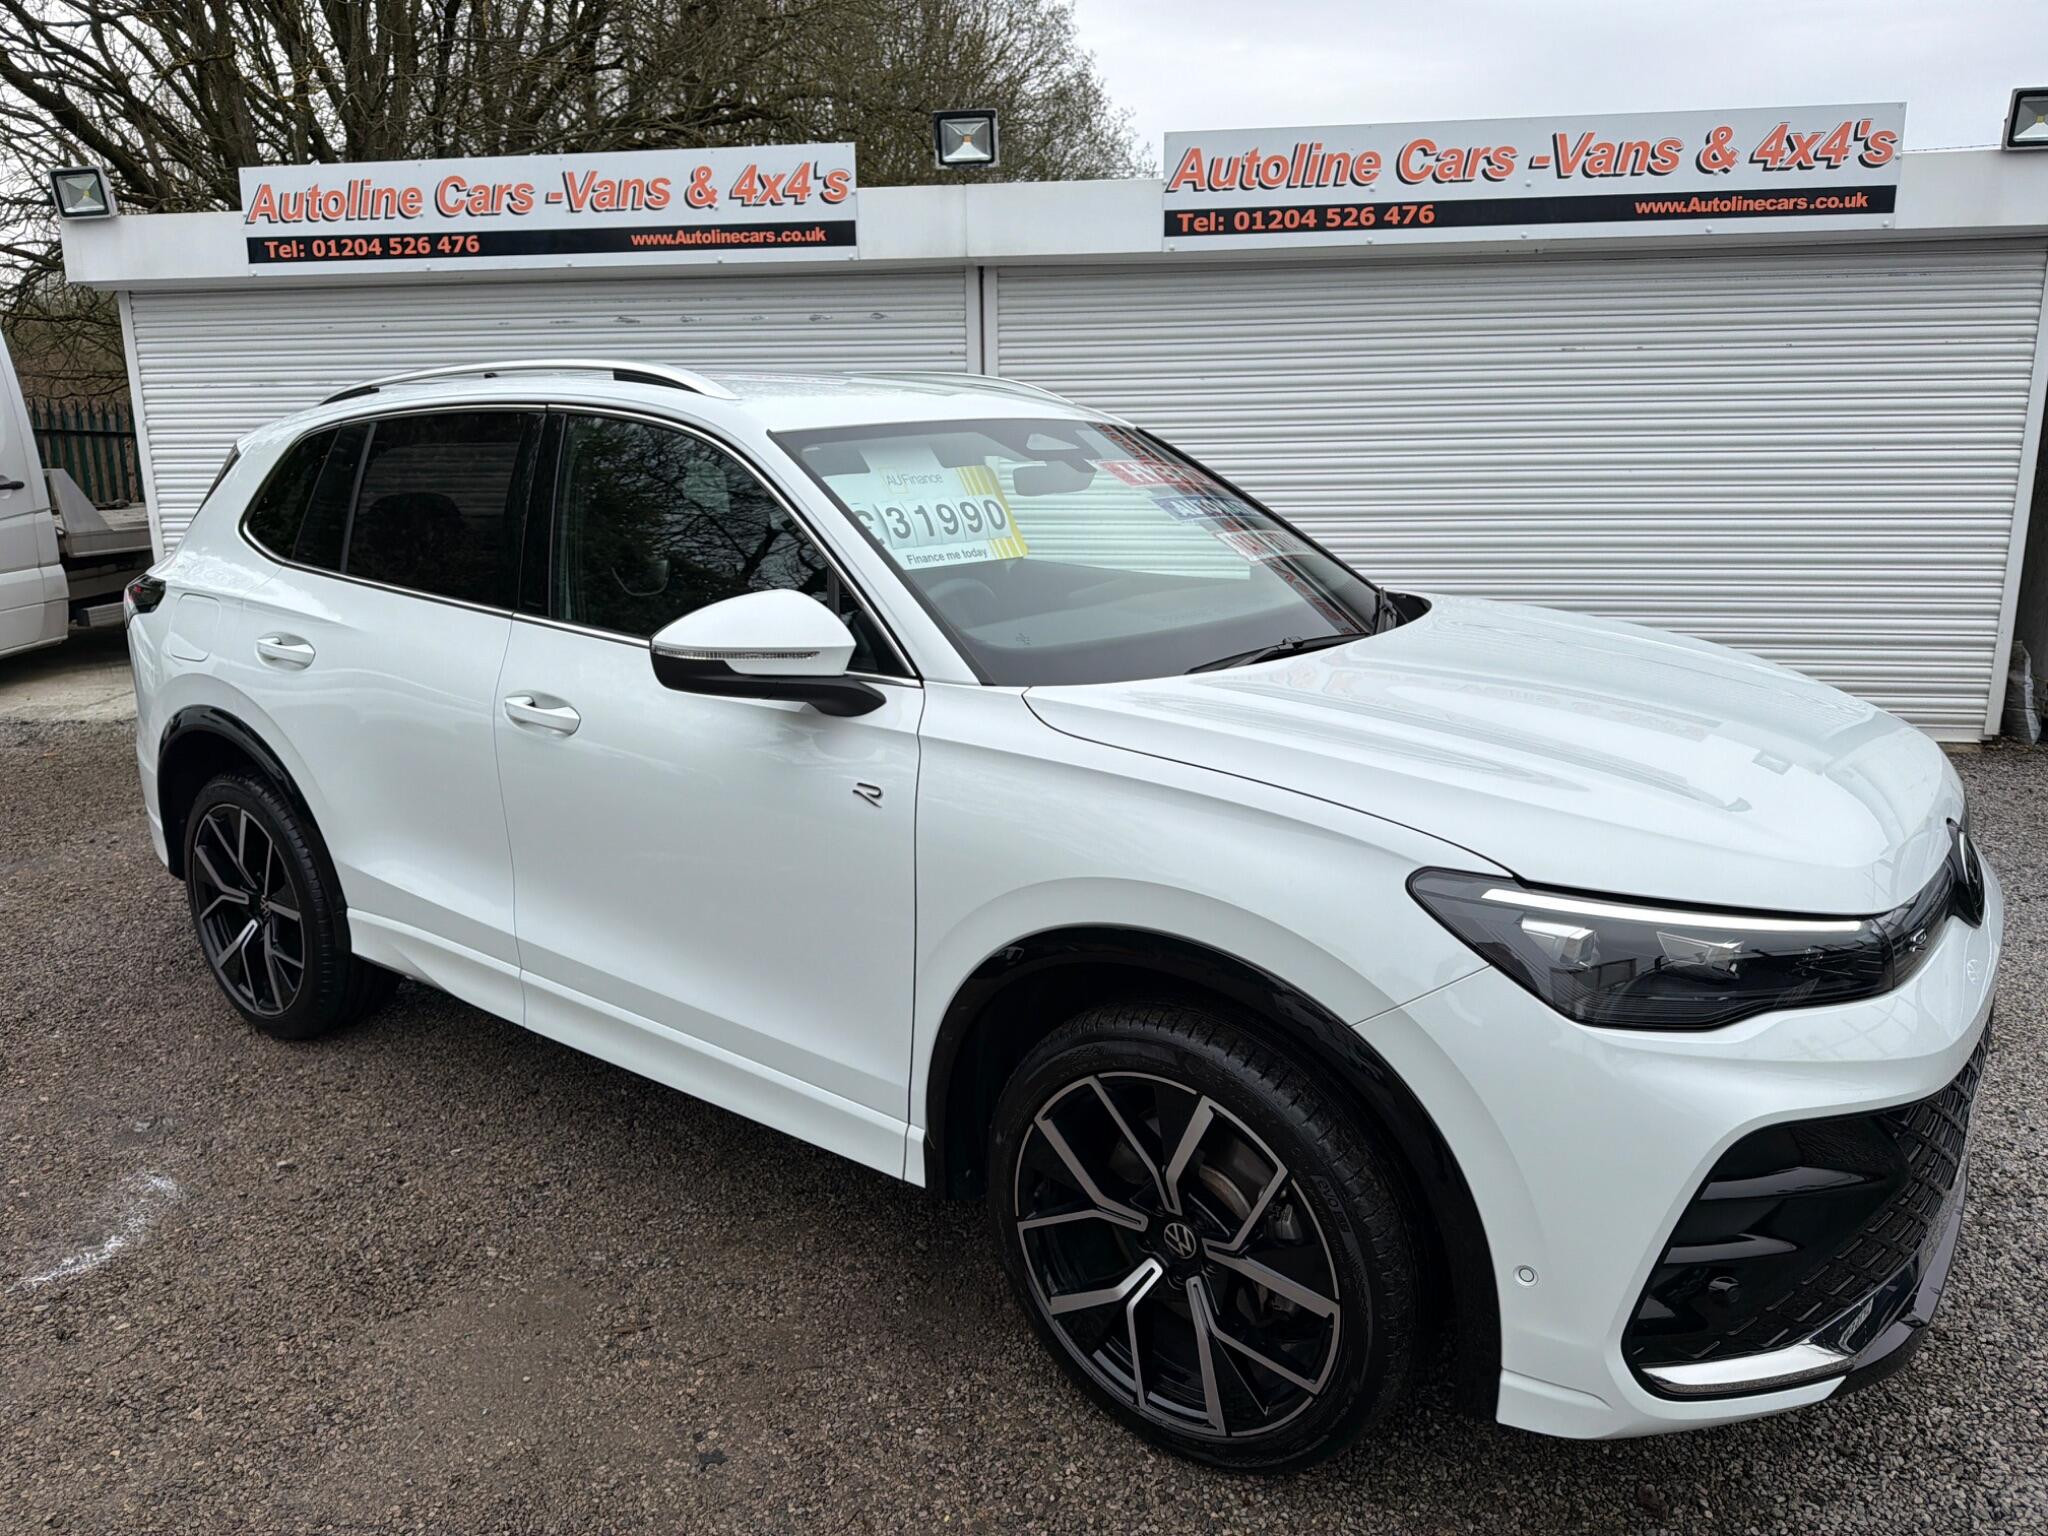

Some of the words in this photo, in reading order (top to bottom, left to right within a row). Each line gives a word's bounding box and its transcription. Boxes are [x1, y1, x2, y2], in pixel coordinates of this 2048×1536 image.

[1164, 142, 1381, 193] Autoline
[1396, 138, 1519, 185] Cars
[1695, 125, 1740, 175] &
[1749, 119, 1899, 172] 4x4's
[245, 178, 423, 224] Autoline
[435, 175, 535, 217] Cars
[685, 165, 718, 209] &
[1635, 192, 1868, 214] www.Autolinecars.co.uk
[1177, 212, 1225, 232] Tel:
[1234, 209, 1317, 231] 01204
[1325, 206, 1376, 228] 526
[1384, 204, 1435, 225] 476
[264, 240, 305, 259] Tel:
[311, 237, 382, 257] 01204
[389, 236, 431, 255] 526
[437, 235, 480, 254] 476
[631, 226, 826, 246] www.Autolinecars.co.uk
[906, 551, 944, 565] Finance
[946, 551, 962, 562] me
[961, 547, 988, 561] today
